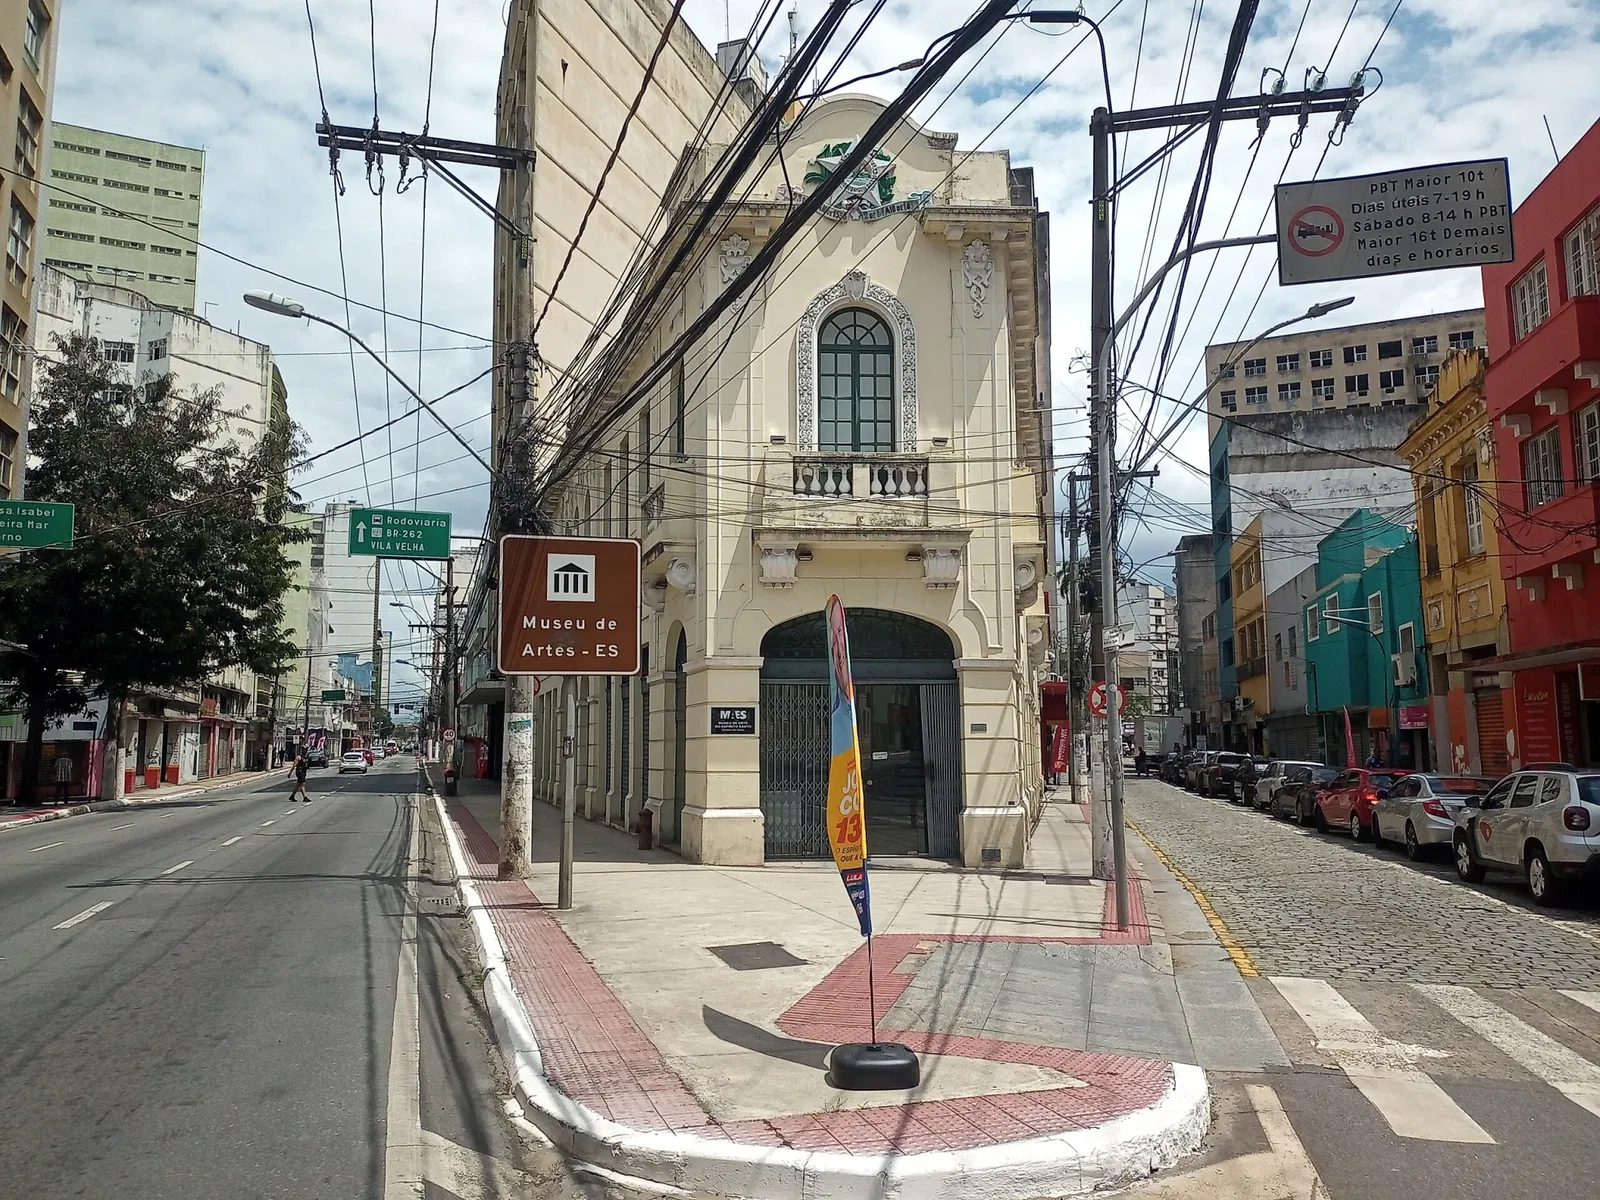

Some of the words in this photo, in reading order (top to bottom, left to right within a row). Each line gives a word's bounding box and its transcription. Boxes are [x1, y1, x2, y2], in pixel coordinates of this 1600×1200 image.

[1370, 180, 1398, 195] PBT
[1405, 174, 1451, 190] Maior
[1458, 170, 1485, 184] 10t
[1352, 201, 1384, 215] Dias
[1392, 195, 1429, 209] úteis
[1353, 216, 1414, 232] Sábado
[1421, 210, 1456, 225] 8-14
[1463, 208, 1473, 219] h
[1479, 204, 1507, 218] PBT
[1357, 235, 1402, 250] Maior
[1410, 230, 1437, 244] 16t
[1443, 223, 1505, 240] Demais
[1367, 252, 1402, 267] dias
[1408, 252, 1417, 262] e
[28, 520, 49, 529] Mar
[386, 529, 423, 539] BR-262
[371, 541, 392, 550] VILA
[395, 542, 425, 552] VELHA
[523, 615, 586, 630] Museu
[596, 617, 617, 630] de
[522, 643, 575, 657] Artes
[595, 644, 619, 657] ES
[836, 814, 862, 844] 13
